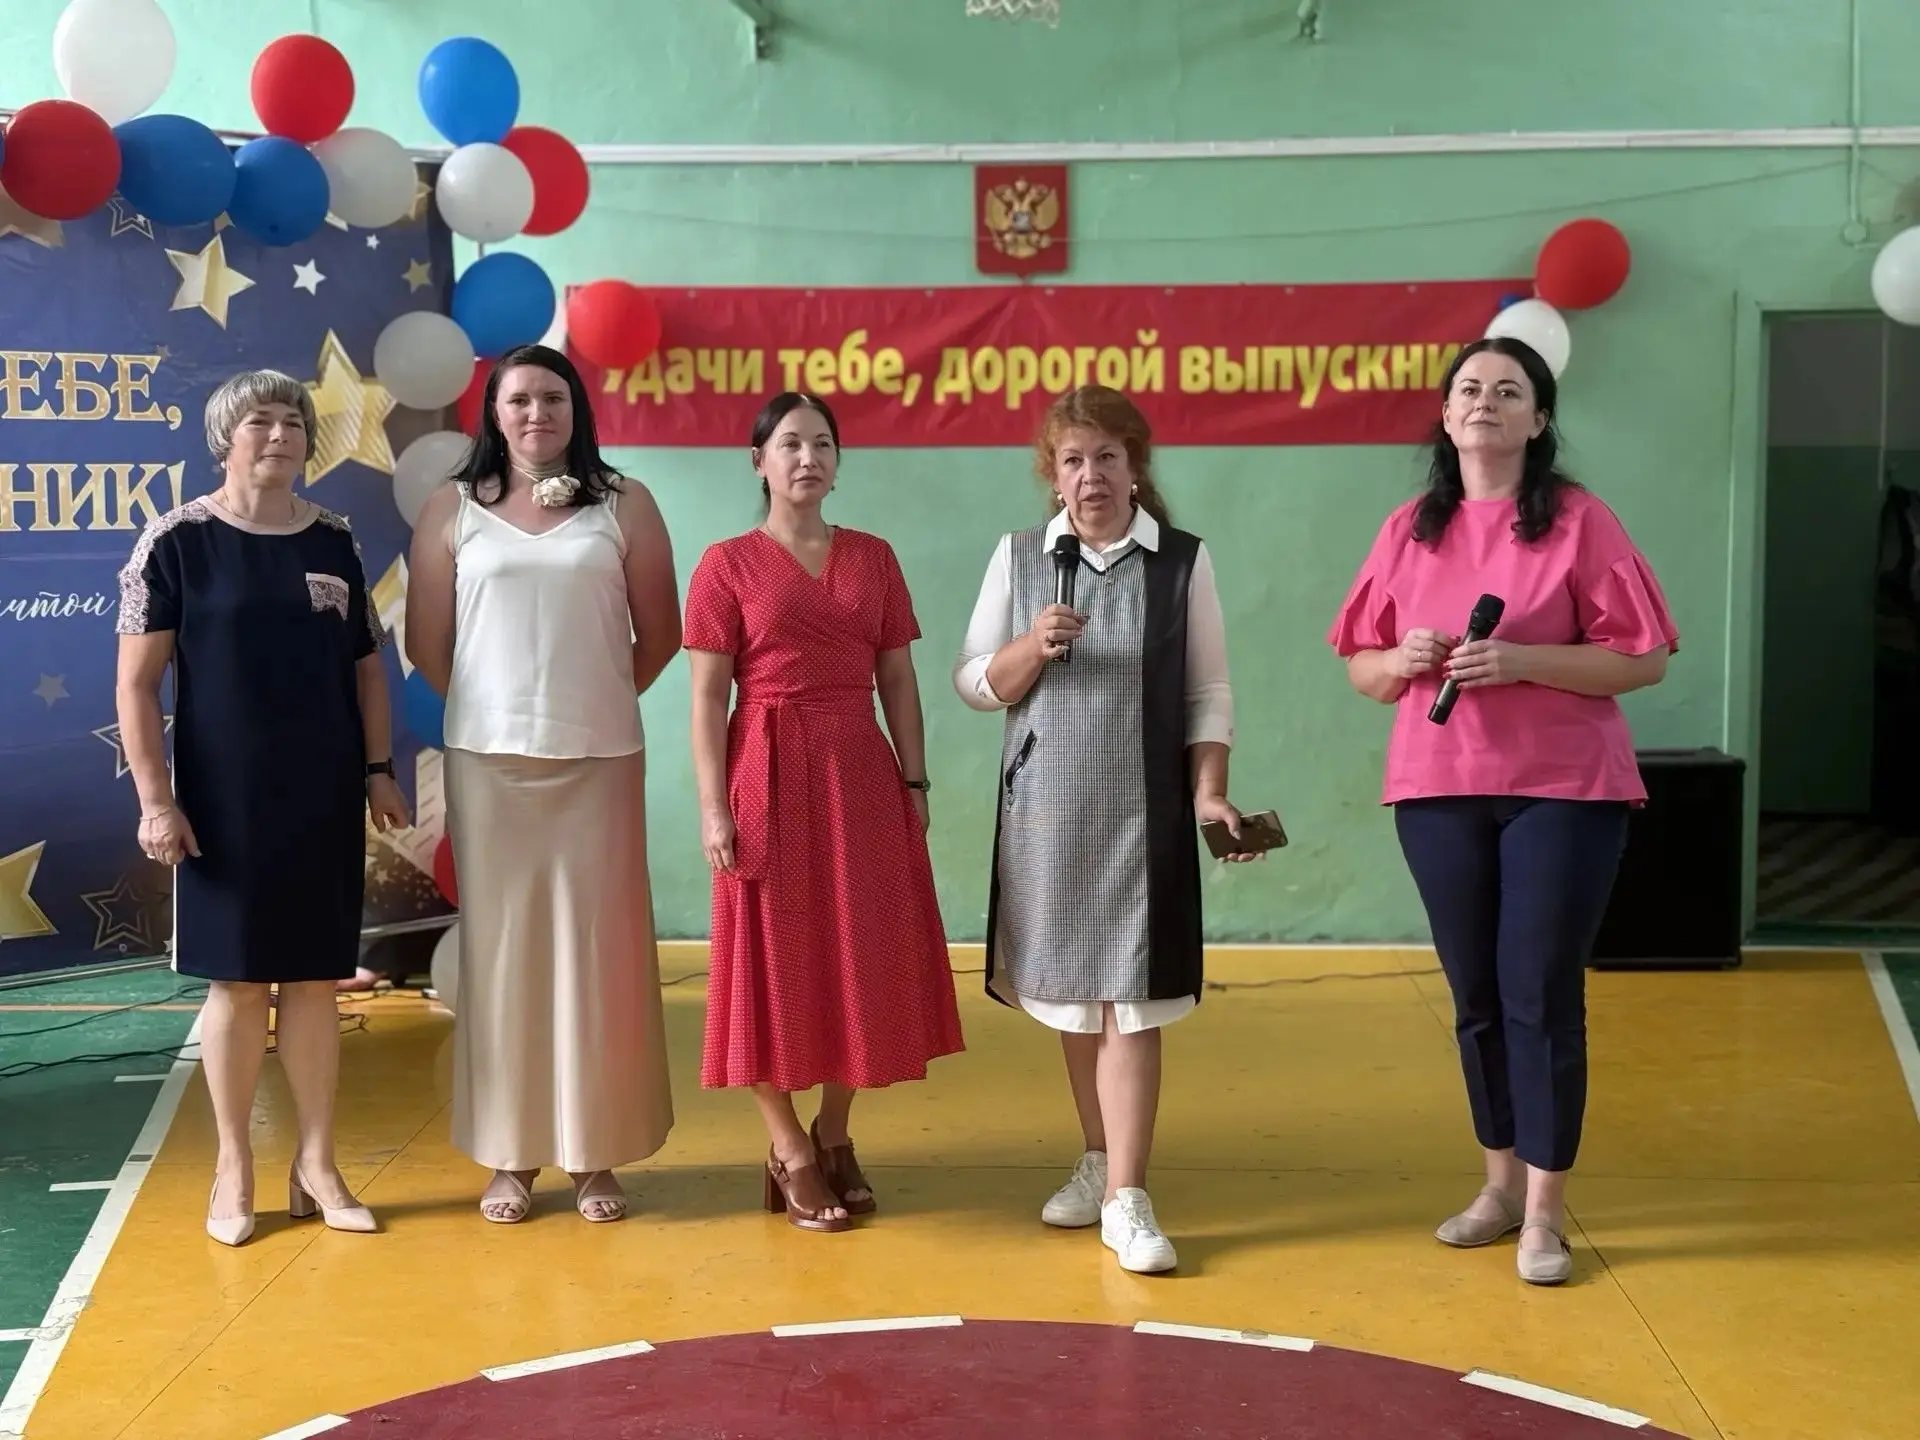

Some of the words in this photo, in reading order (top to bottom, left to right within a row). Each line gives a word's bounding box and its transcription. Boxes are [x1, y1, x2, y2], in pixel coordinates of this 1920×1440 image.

[778, 329, 922, 406] тебе,
[933, 329, 1164, 410] дорогой
[1180, 342, 1470, 408] выпускни
